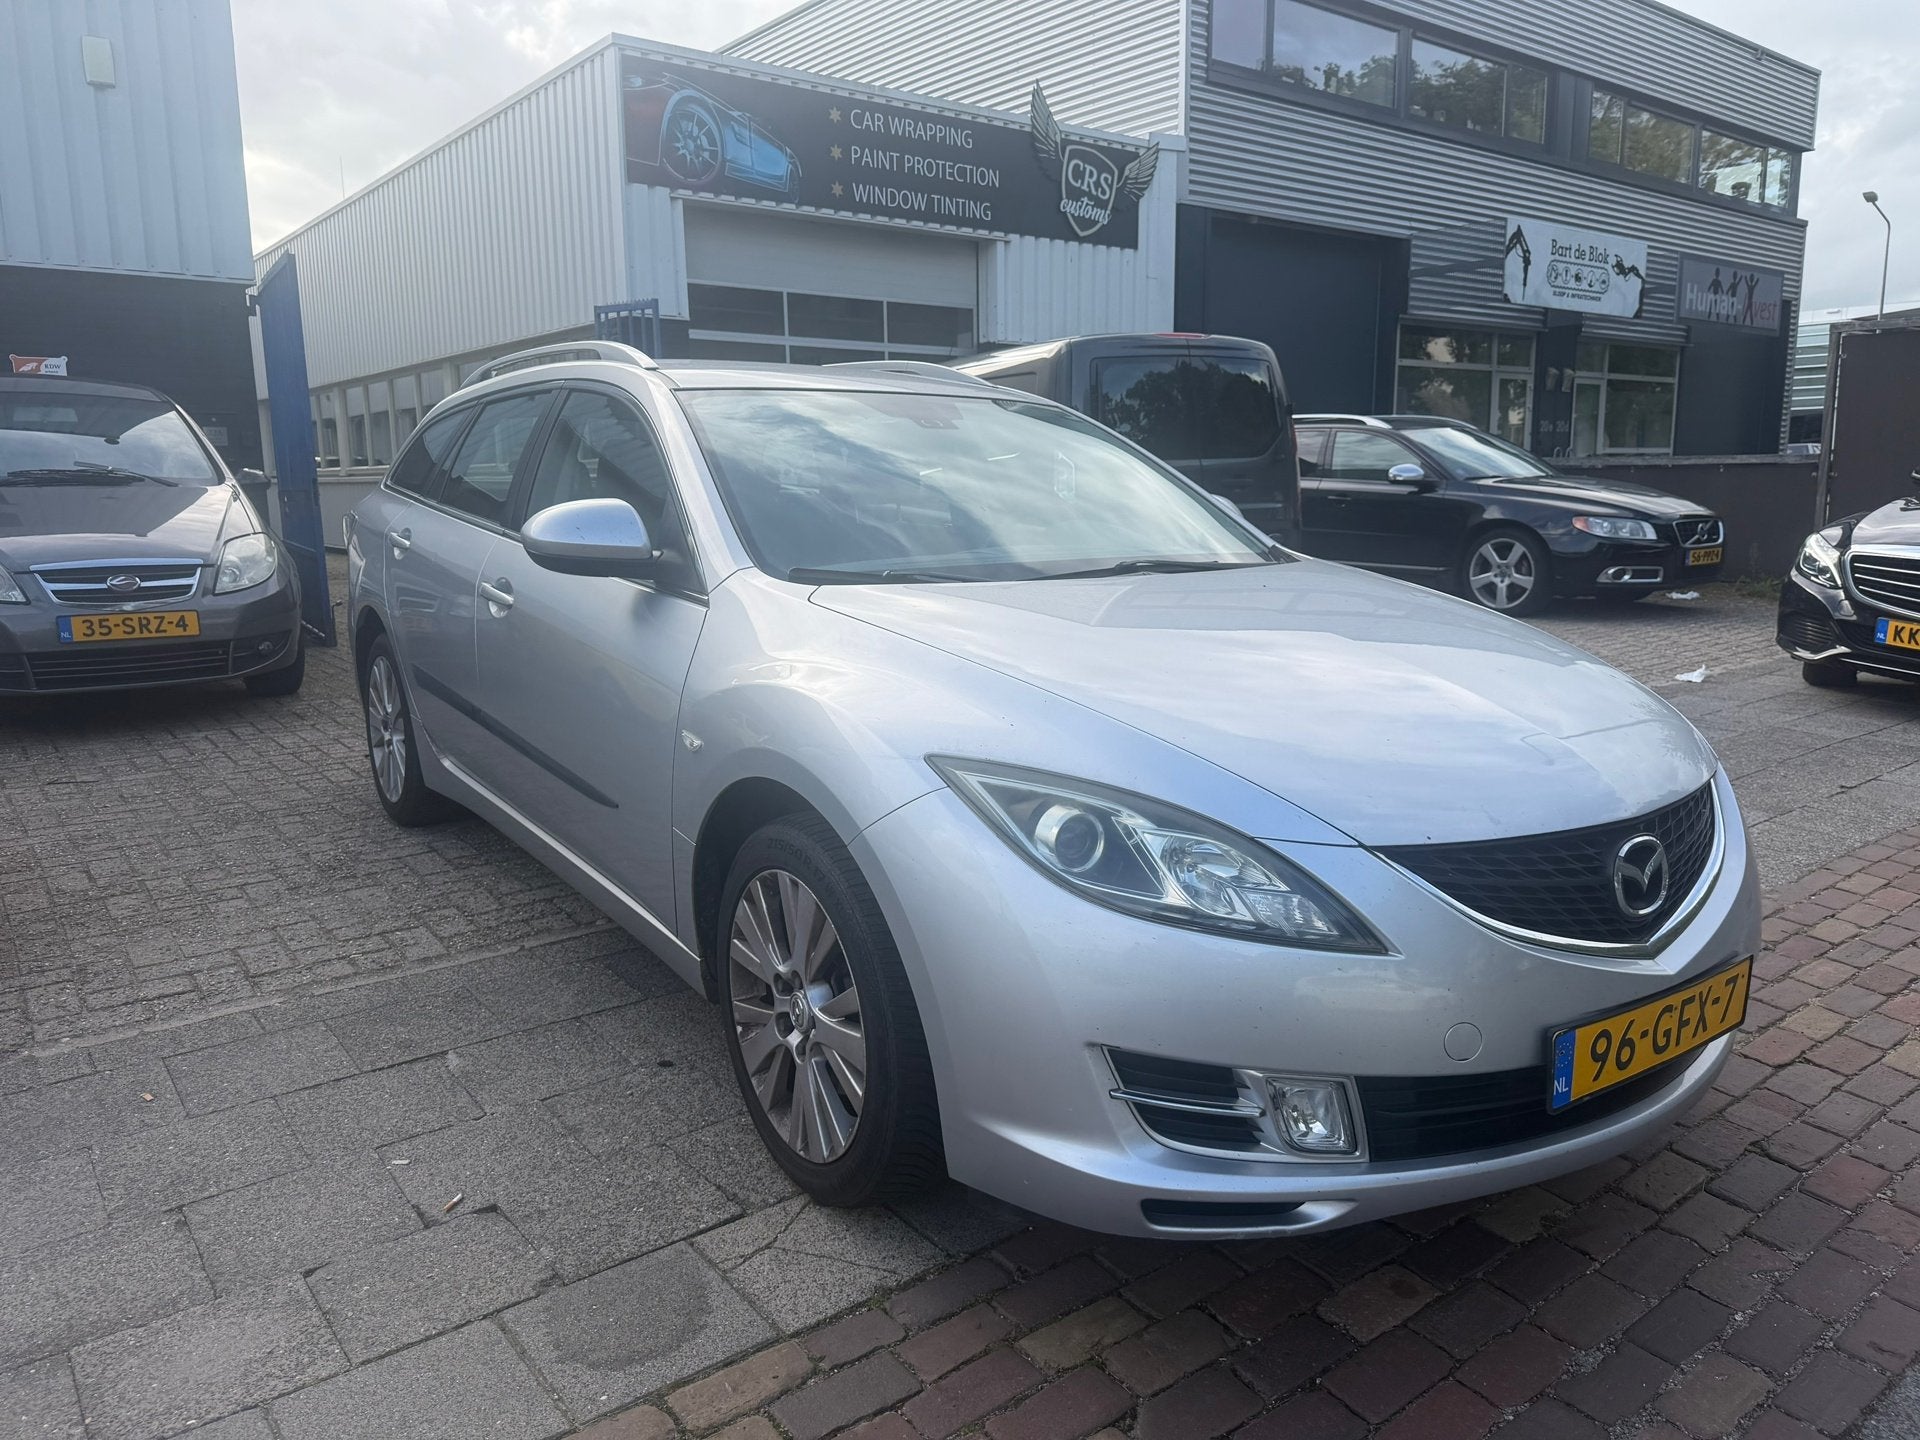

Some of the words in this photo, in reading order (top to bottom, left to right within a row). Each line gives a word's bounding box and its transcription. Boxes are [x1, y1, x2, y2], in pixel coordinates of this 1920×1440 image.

[850, 109, 884, 133] CAR
[888, 115, 973, 149] WRAPPING
[851, 145, 900, 171] PAINT
[904, 154, 1000, 188] PROTECTION
[1067, 159, 1112, 200] CRS
[852, 182, 928, 212] WINDOW
[931, 194, 992, 221] TINTING
[1060, 196, 1112, 225] customs
[1551, 239, 1572, 259] Bart
[1574, 243, 1587, 260] de
[1588, 245, 1610, 265] Blok
[81, 614, 189, 637] 35-SRZ-4
[1893, 625, 1920, 646] KK
[1553, 1076, 1569, 1096] NL
[1590, 973, 1739, 1082] 96-GFX-7
